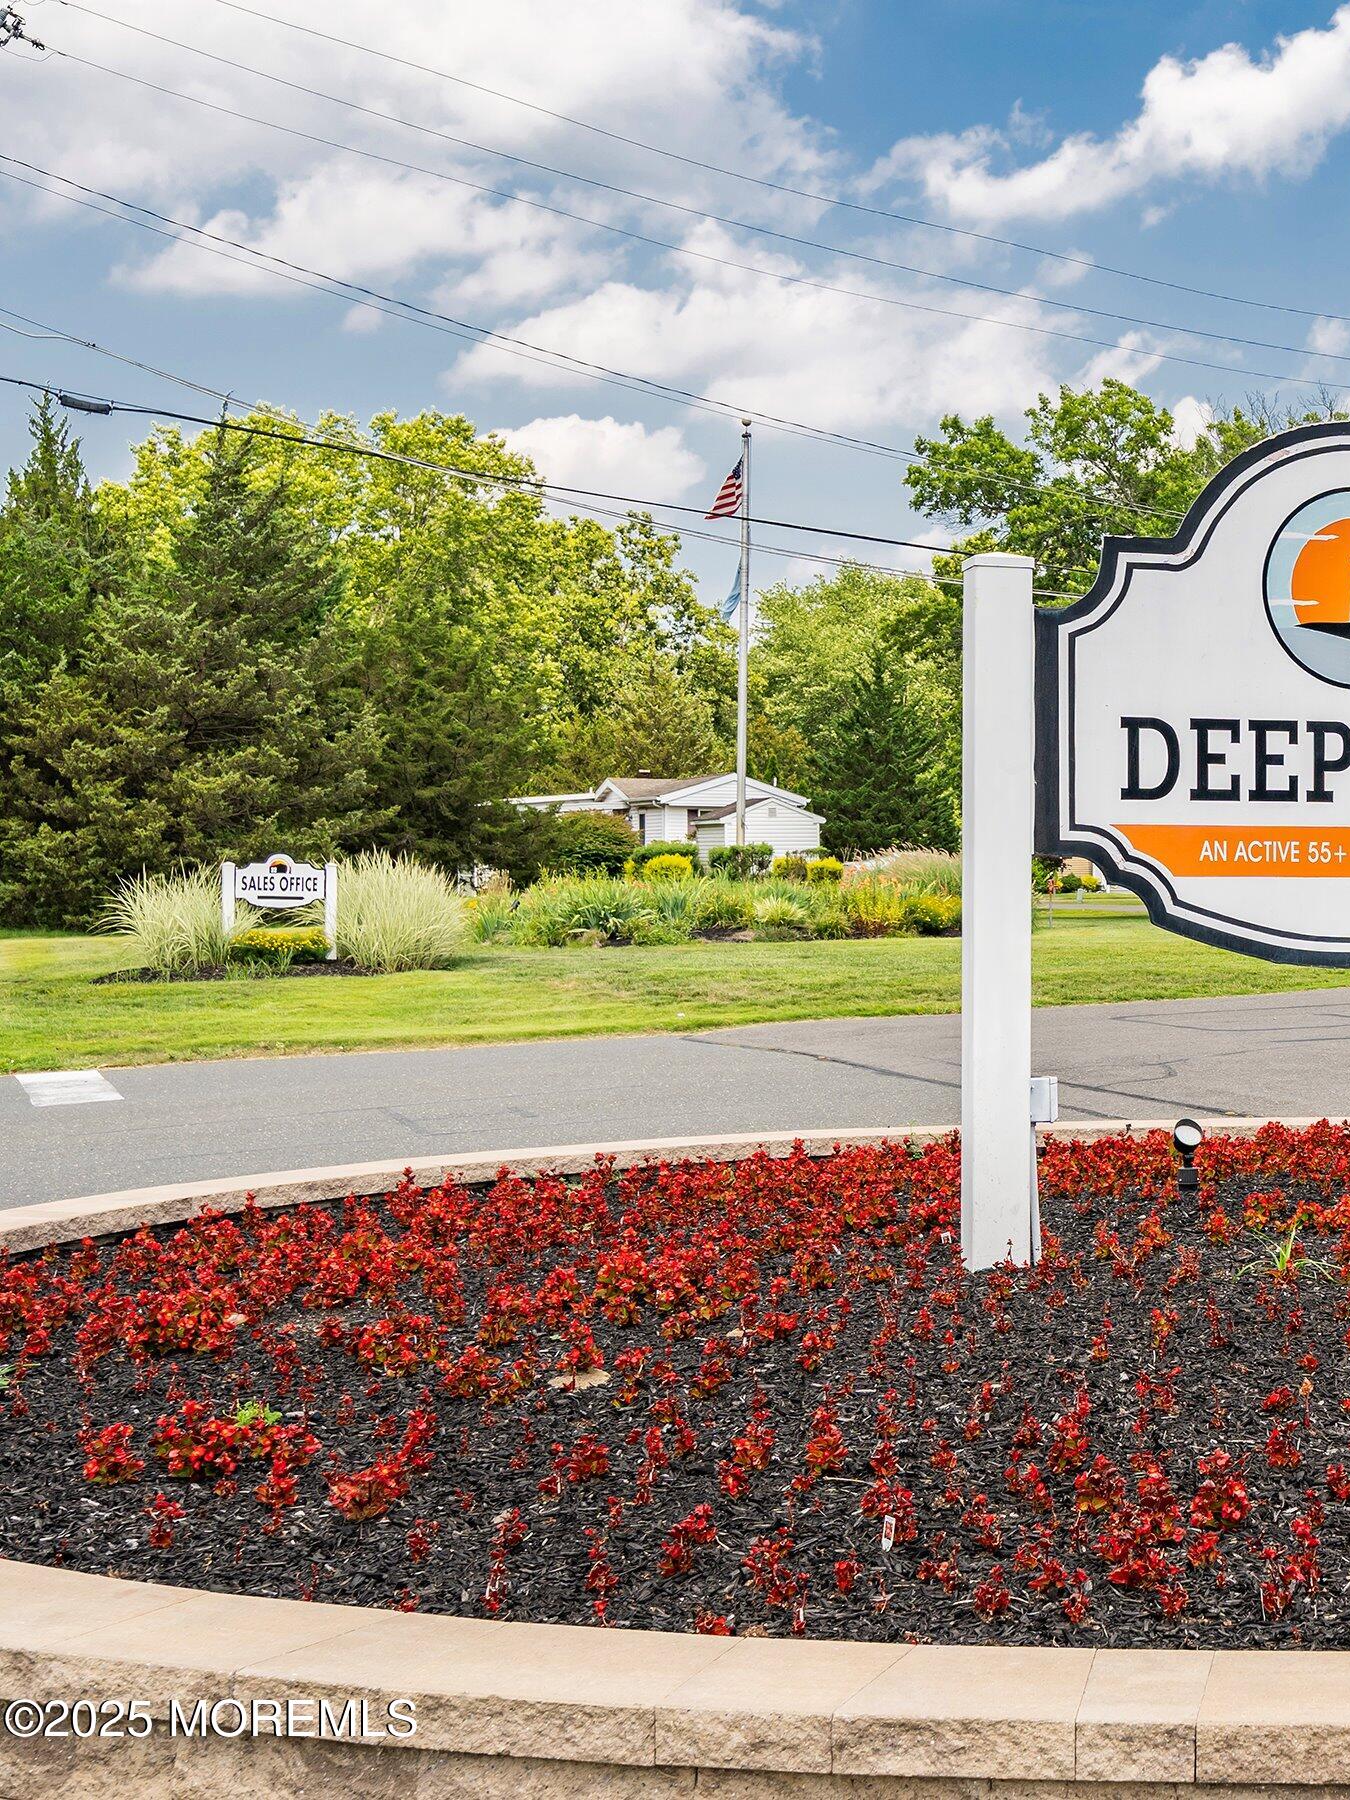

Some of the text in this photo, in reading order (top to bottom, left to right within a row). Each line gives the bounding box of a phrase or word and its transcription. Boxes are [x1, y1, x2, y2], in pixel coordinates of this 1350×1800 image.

[1199, 840, 1227, 862] AN
[1233, 840, 1300, 863] ACTIVE
[1307, 841, 1347, 863] 55+
[241, 875, 318, 892] SALES OFFICE
